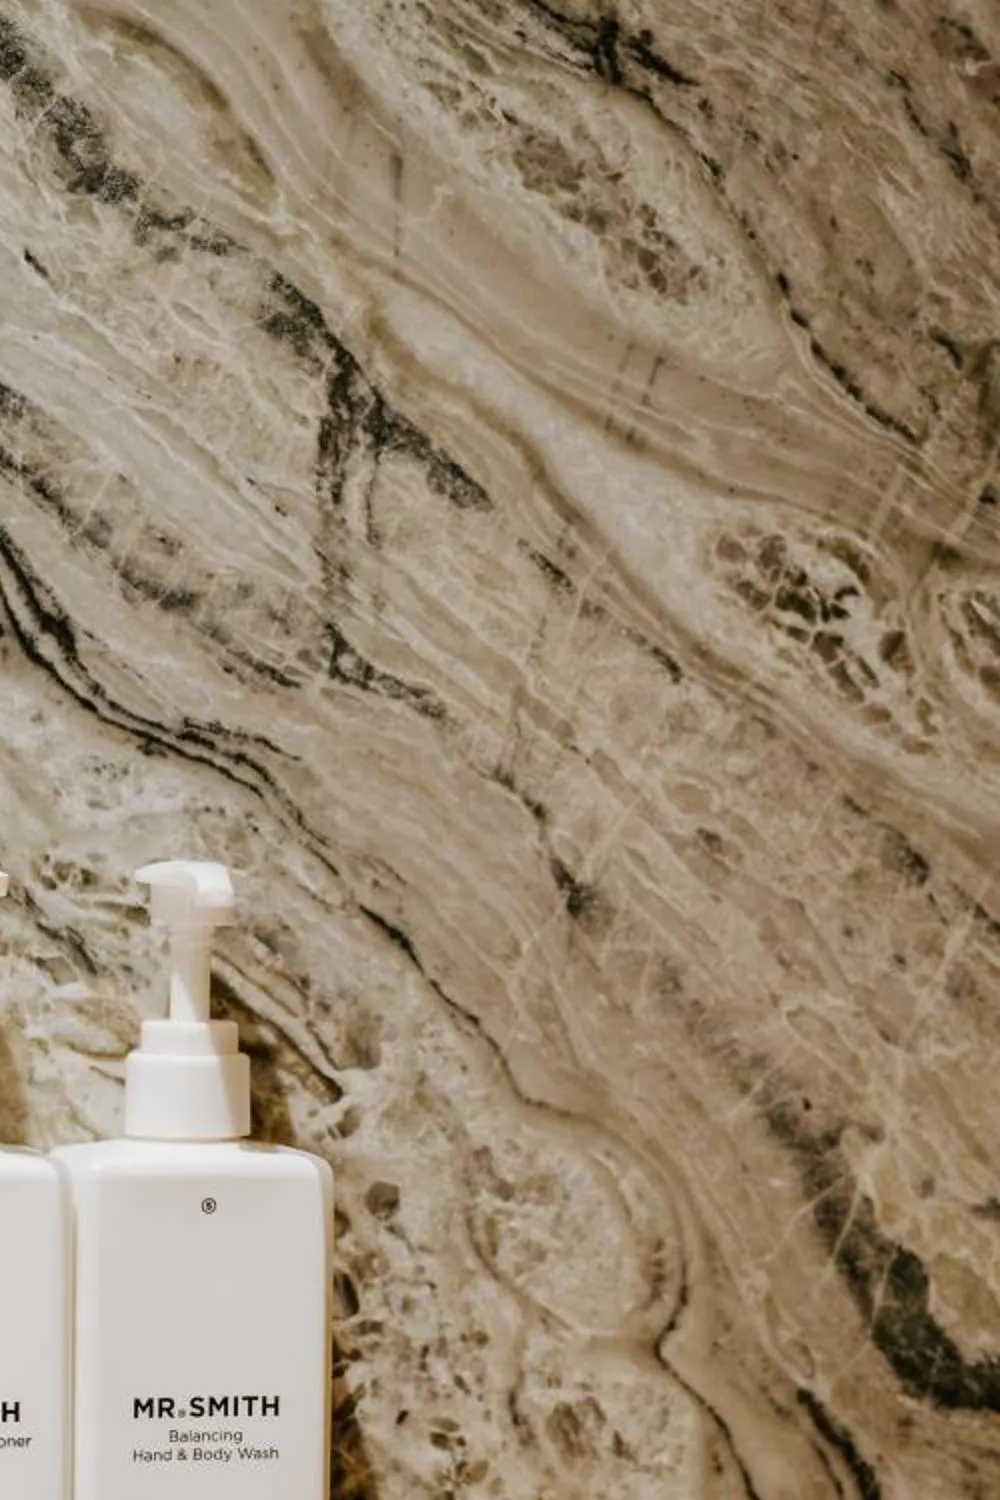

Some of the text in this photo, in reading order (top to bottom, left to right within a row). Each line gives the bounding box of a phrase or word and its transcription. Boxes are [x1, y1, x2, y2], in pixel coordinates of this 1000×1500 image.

[168, 1428, 243, 1444] Balancing
[132, 1446, 280, 1463] Hand & Body Wash
